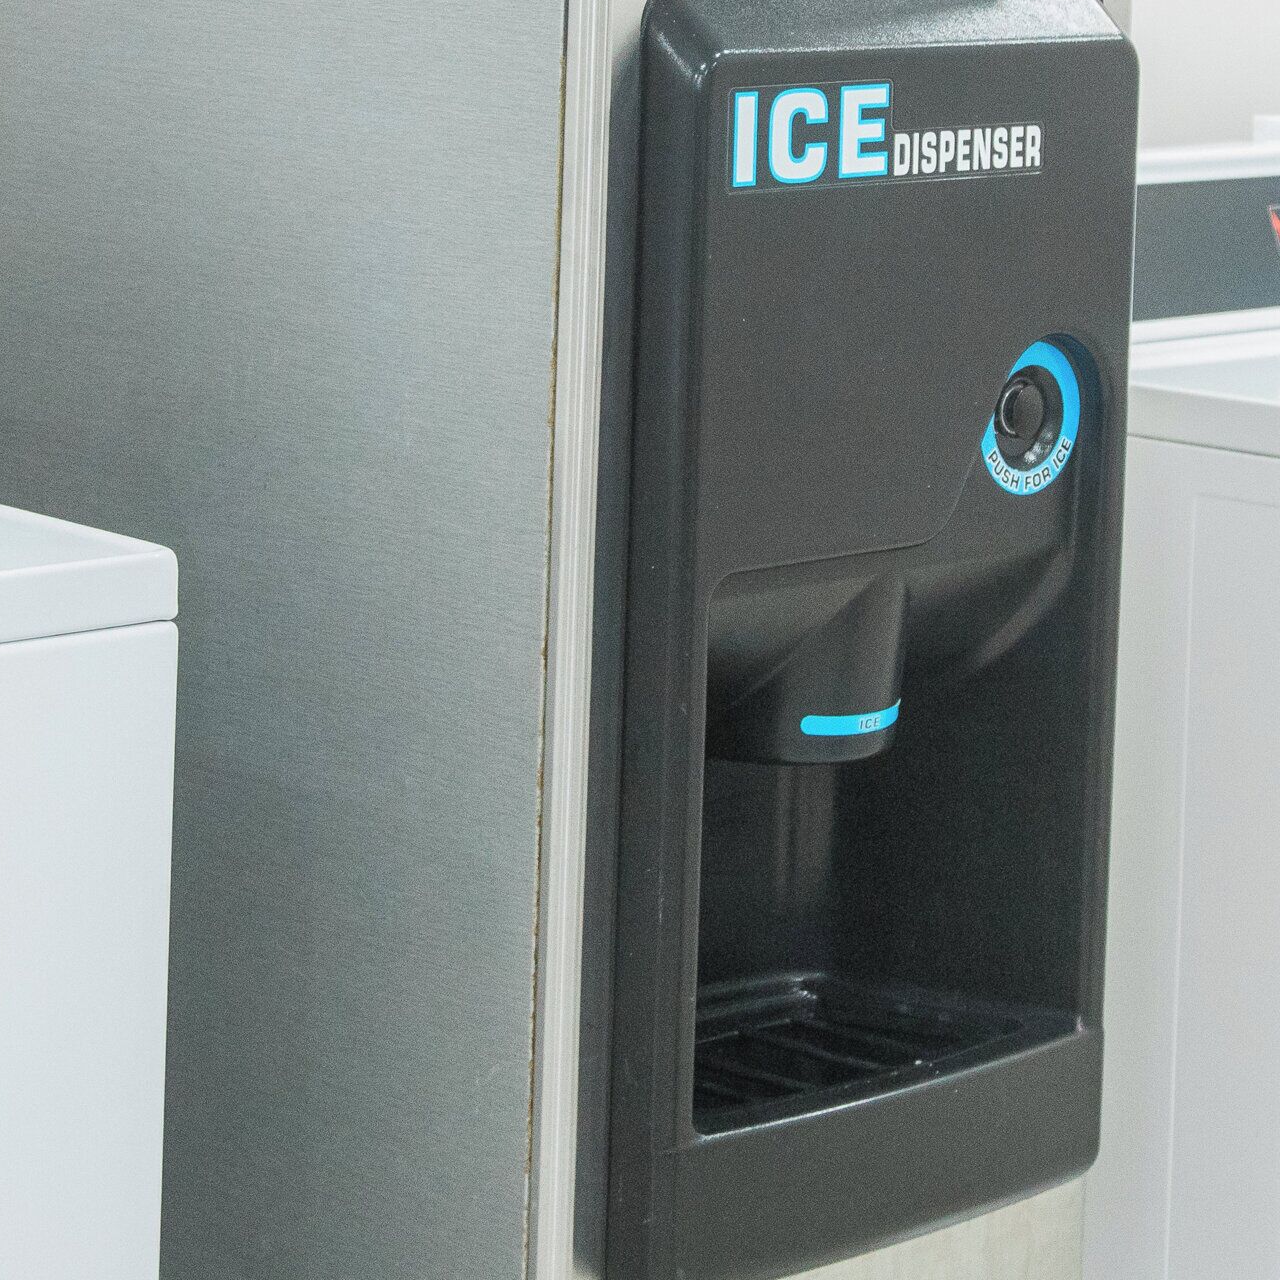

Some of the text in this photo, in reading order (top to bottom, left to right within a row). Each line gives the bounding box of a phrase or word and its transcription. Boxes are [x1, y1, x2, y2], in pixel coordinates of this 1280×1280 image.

[732, 83, 1042, 188] ICE DISPENSER
[987, 437, 1071, 490] PUSH FOR ICE
[860, 718, 880, 729] ICE
